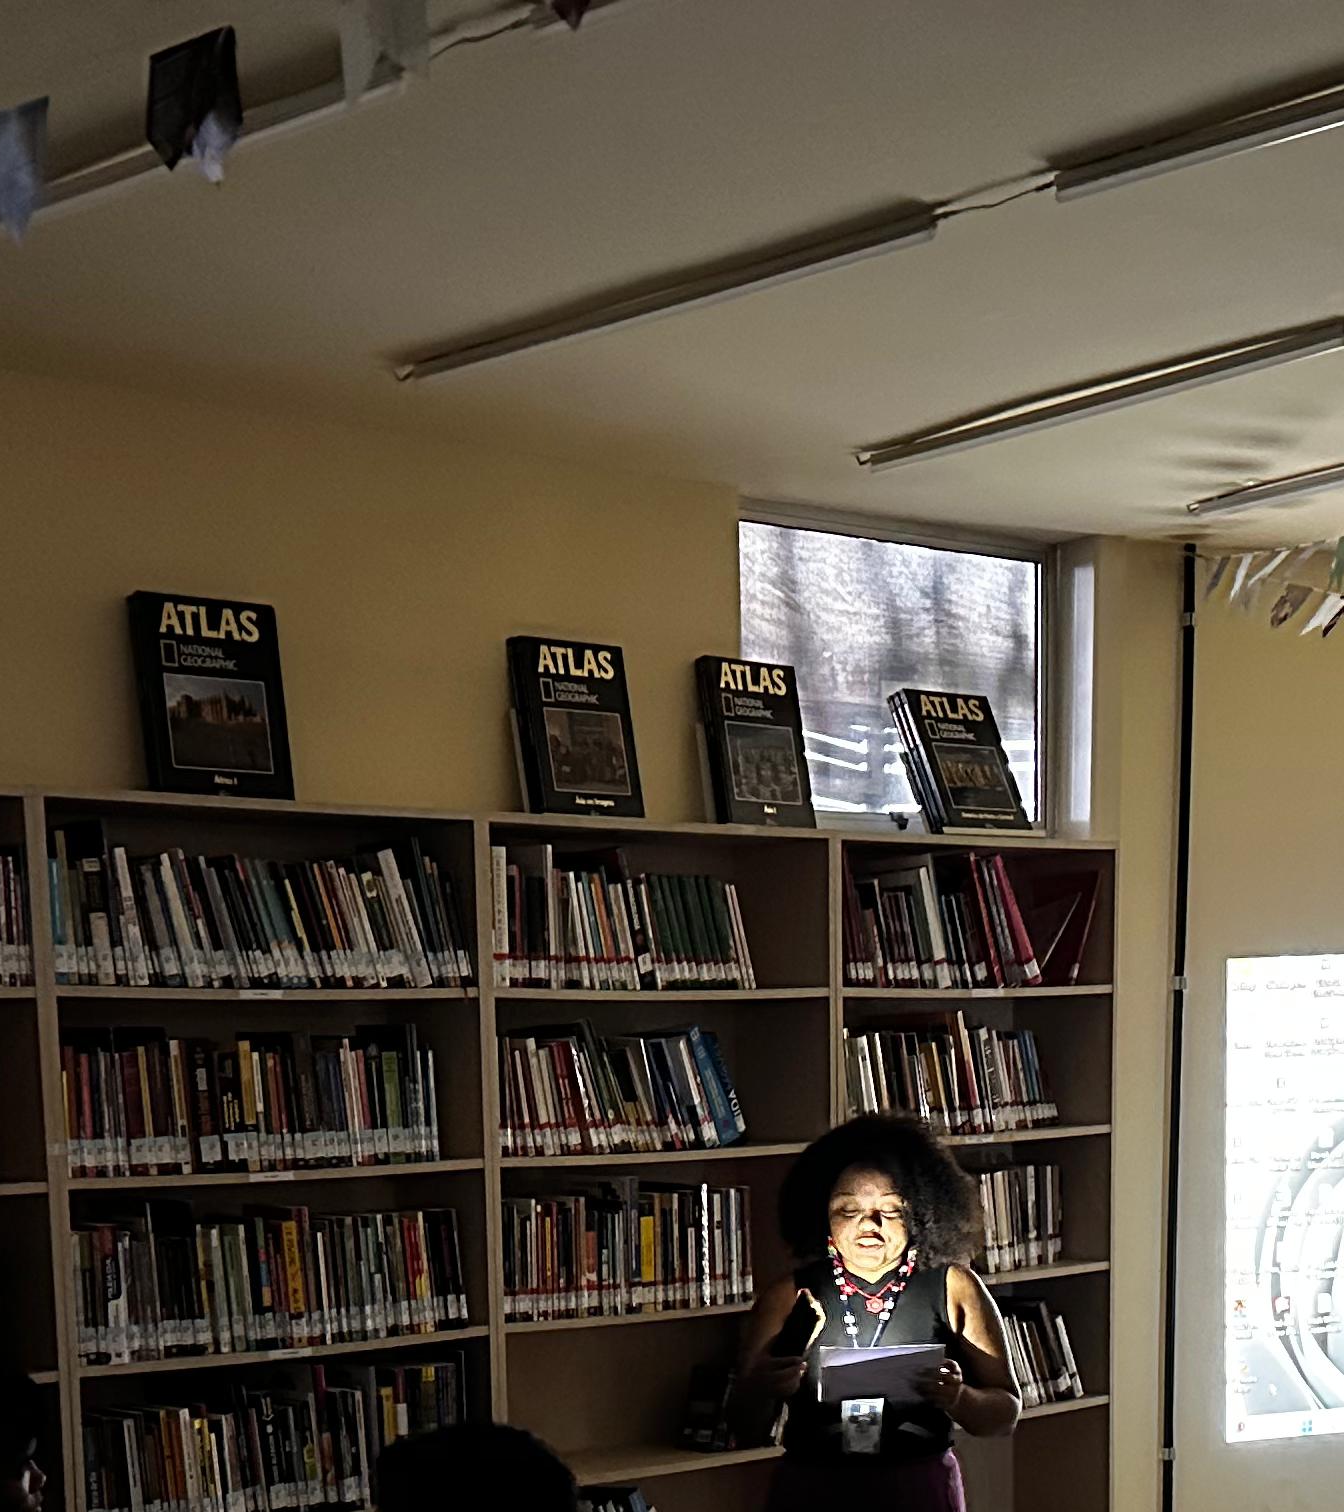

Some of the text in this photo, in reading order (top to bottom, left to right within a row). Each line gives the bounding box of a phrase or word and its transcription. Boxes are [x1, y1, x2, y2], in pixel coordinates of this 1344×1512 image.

[159, 602, 261, 643] ATLAS
[179, 643, 224, 658] NATIONAL
[180, 655, 239, 671] GEOGRAPHIC
[537, 644, 614, 680] ATLAS
[555, 681, 589, 694] NATIONAL
[719, 662, 787, 697] ATLAS
[556, 692, 600, 705] GEOGRAPHIC
[919, 694, 984, 722] ATLAS
